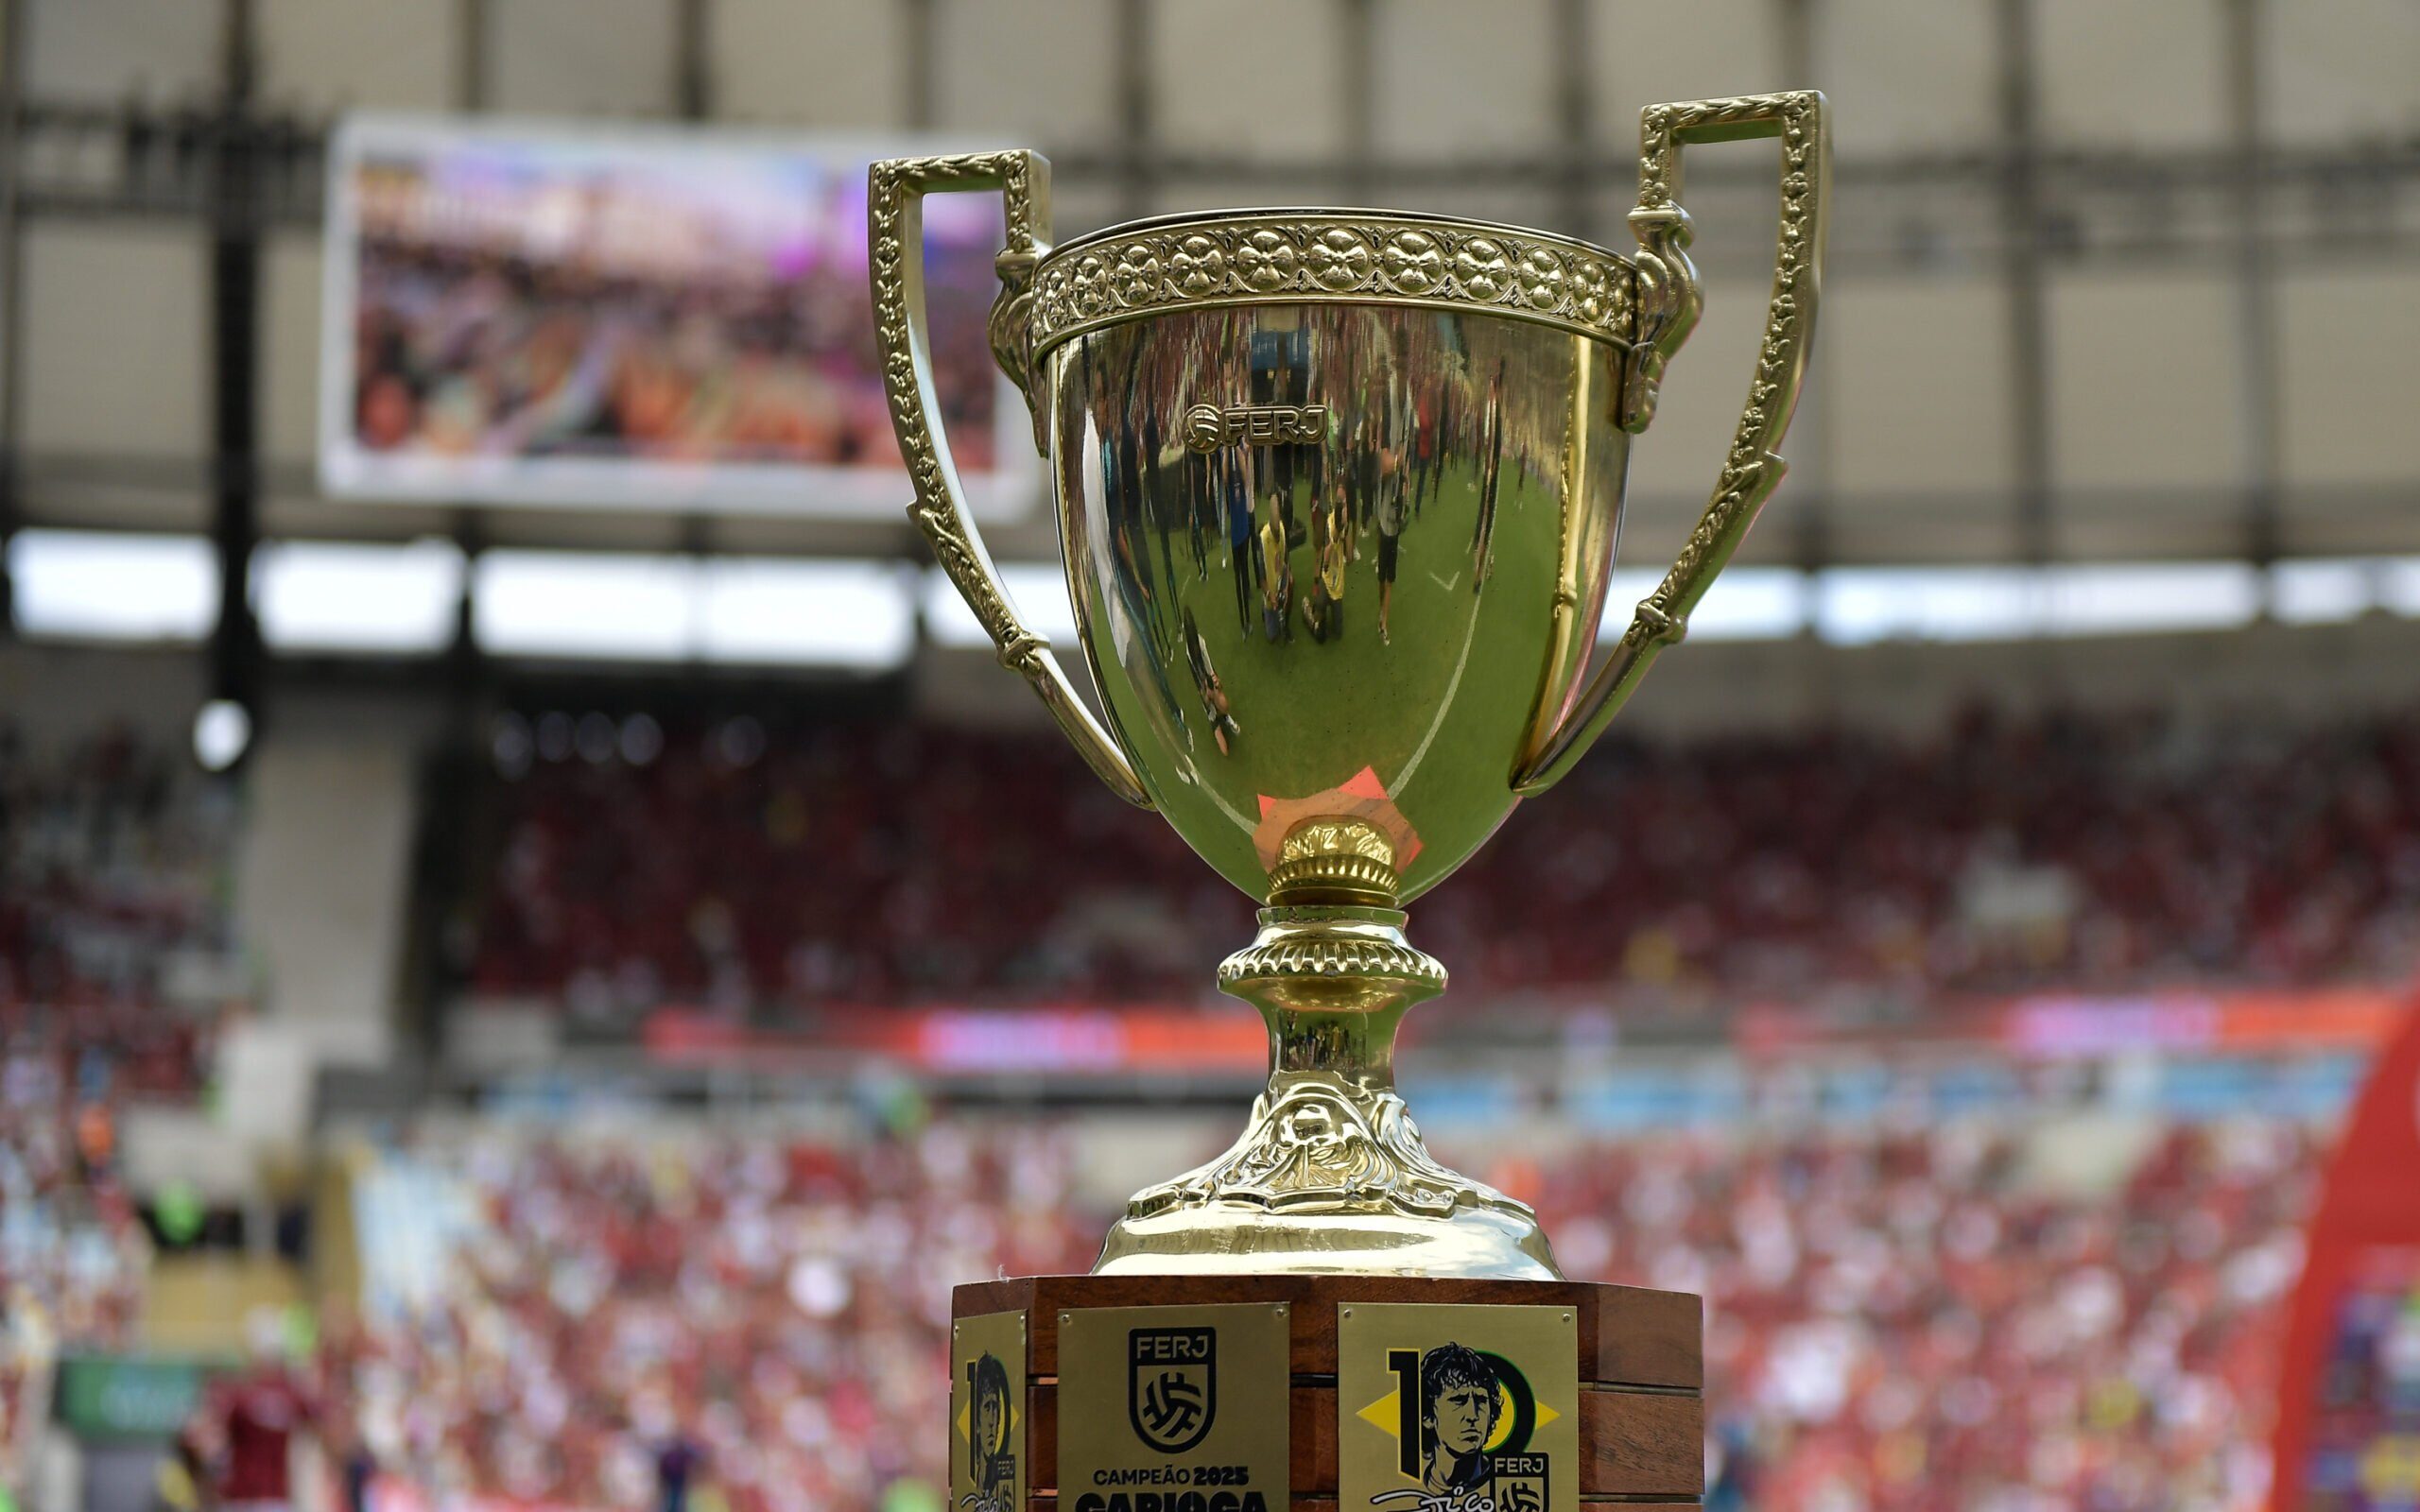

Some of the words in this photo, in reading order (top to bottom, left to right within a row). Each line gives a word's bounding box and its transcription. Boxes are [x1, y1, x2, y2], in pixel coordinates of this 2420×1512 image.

[1224, 409, 1325, 441] FERJ
[1136, 1335, 1208, 1360] FERJ
[1093, 1464, 1190, 1486] CAMPEÃO
[1193, 1466, 1250, 1486] 2025
[1495, 1457, 1544, 1474] FERJ
